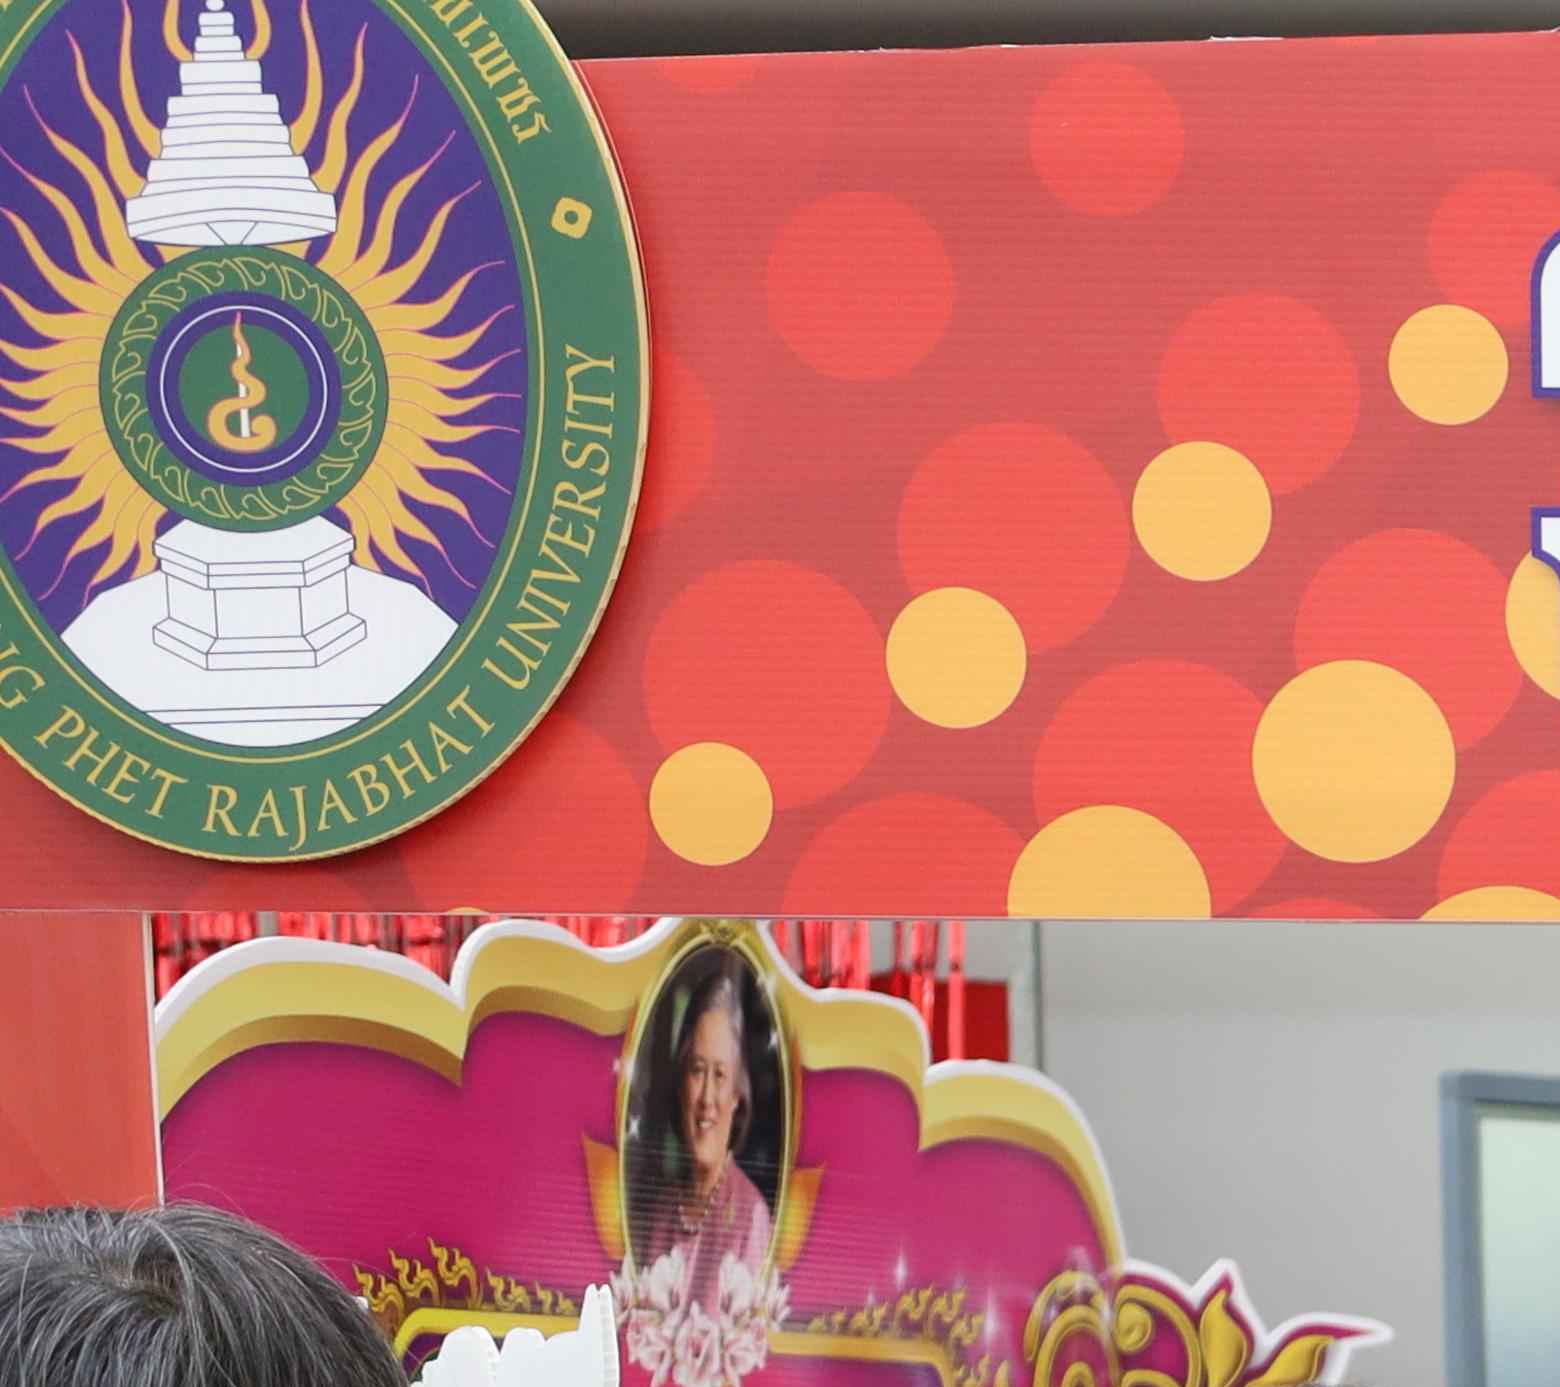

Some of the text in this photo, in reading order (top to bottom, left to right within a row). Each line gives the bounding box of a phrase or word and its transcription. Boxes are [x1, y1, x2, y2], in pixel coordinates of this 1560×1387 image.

[0, 343, 617, 851] G PHET RAJABHAT UNIVERSITY
